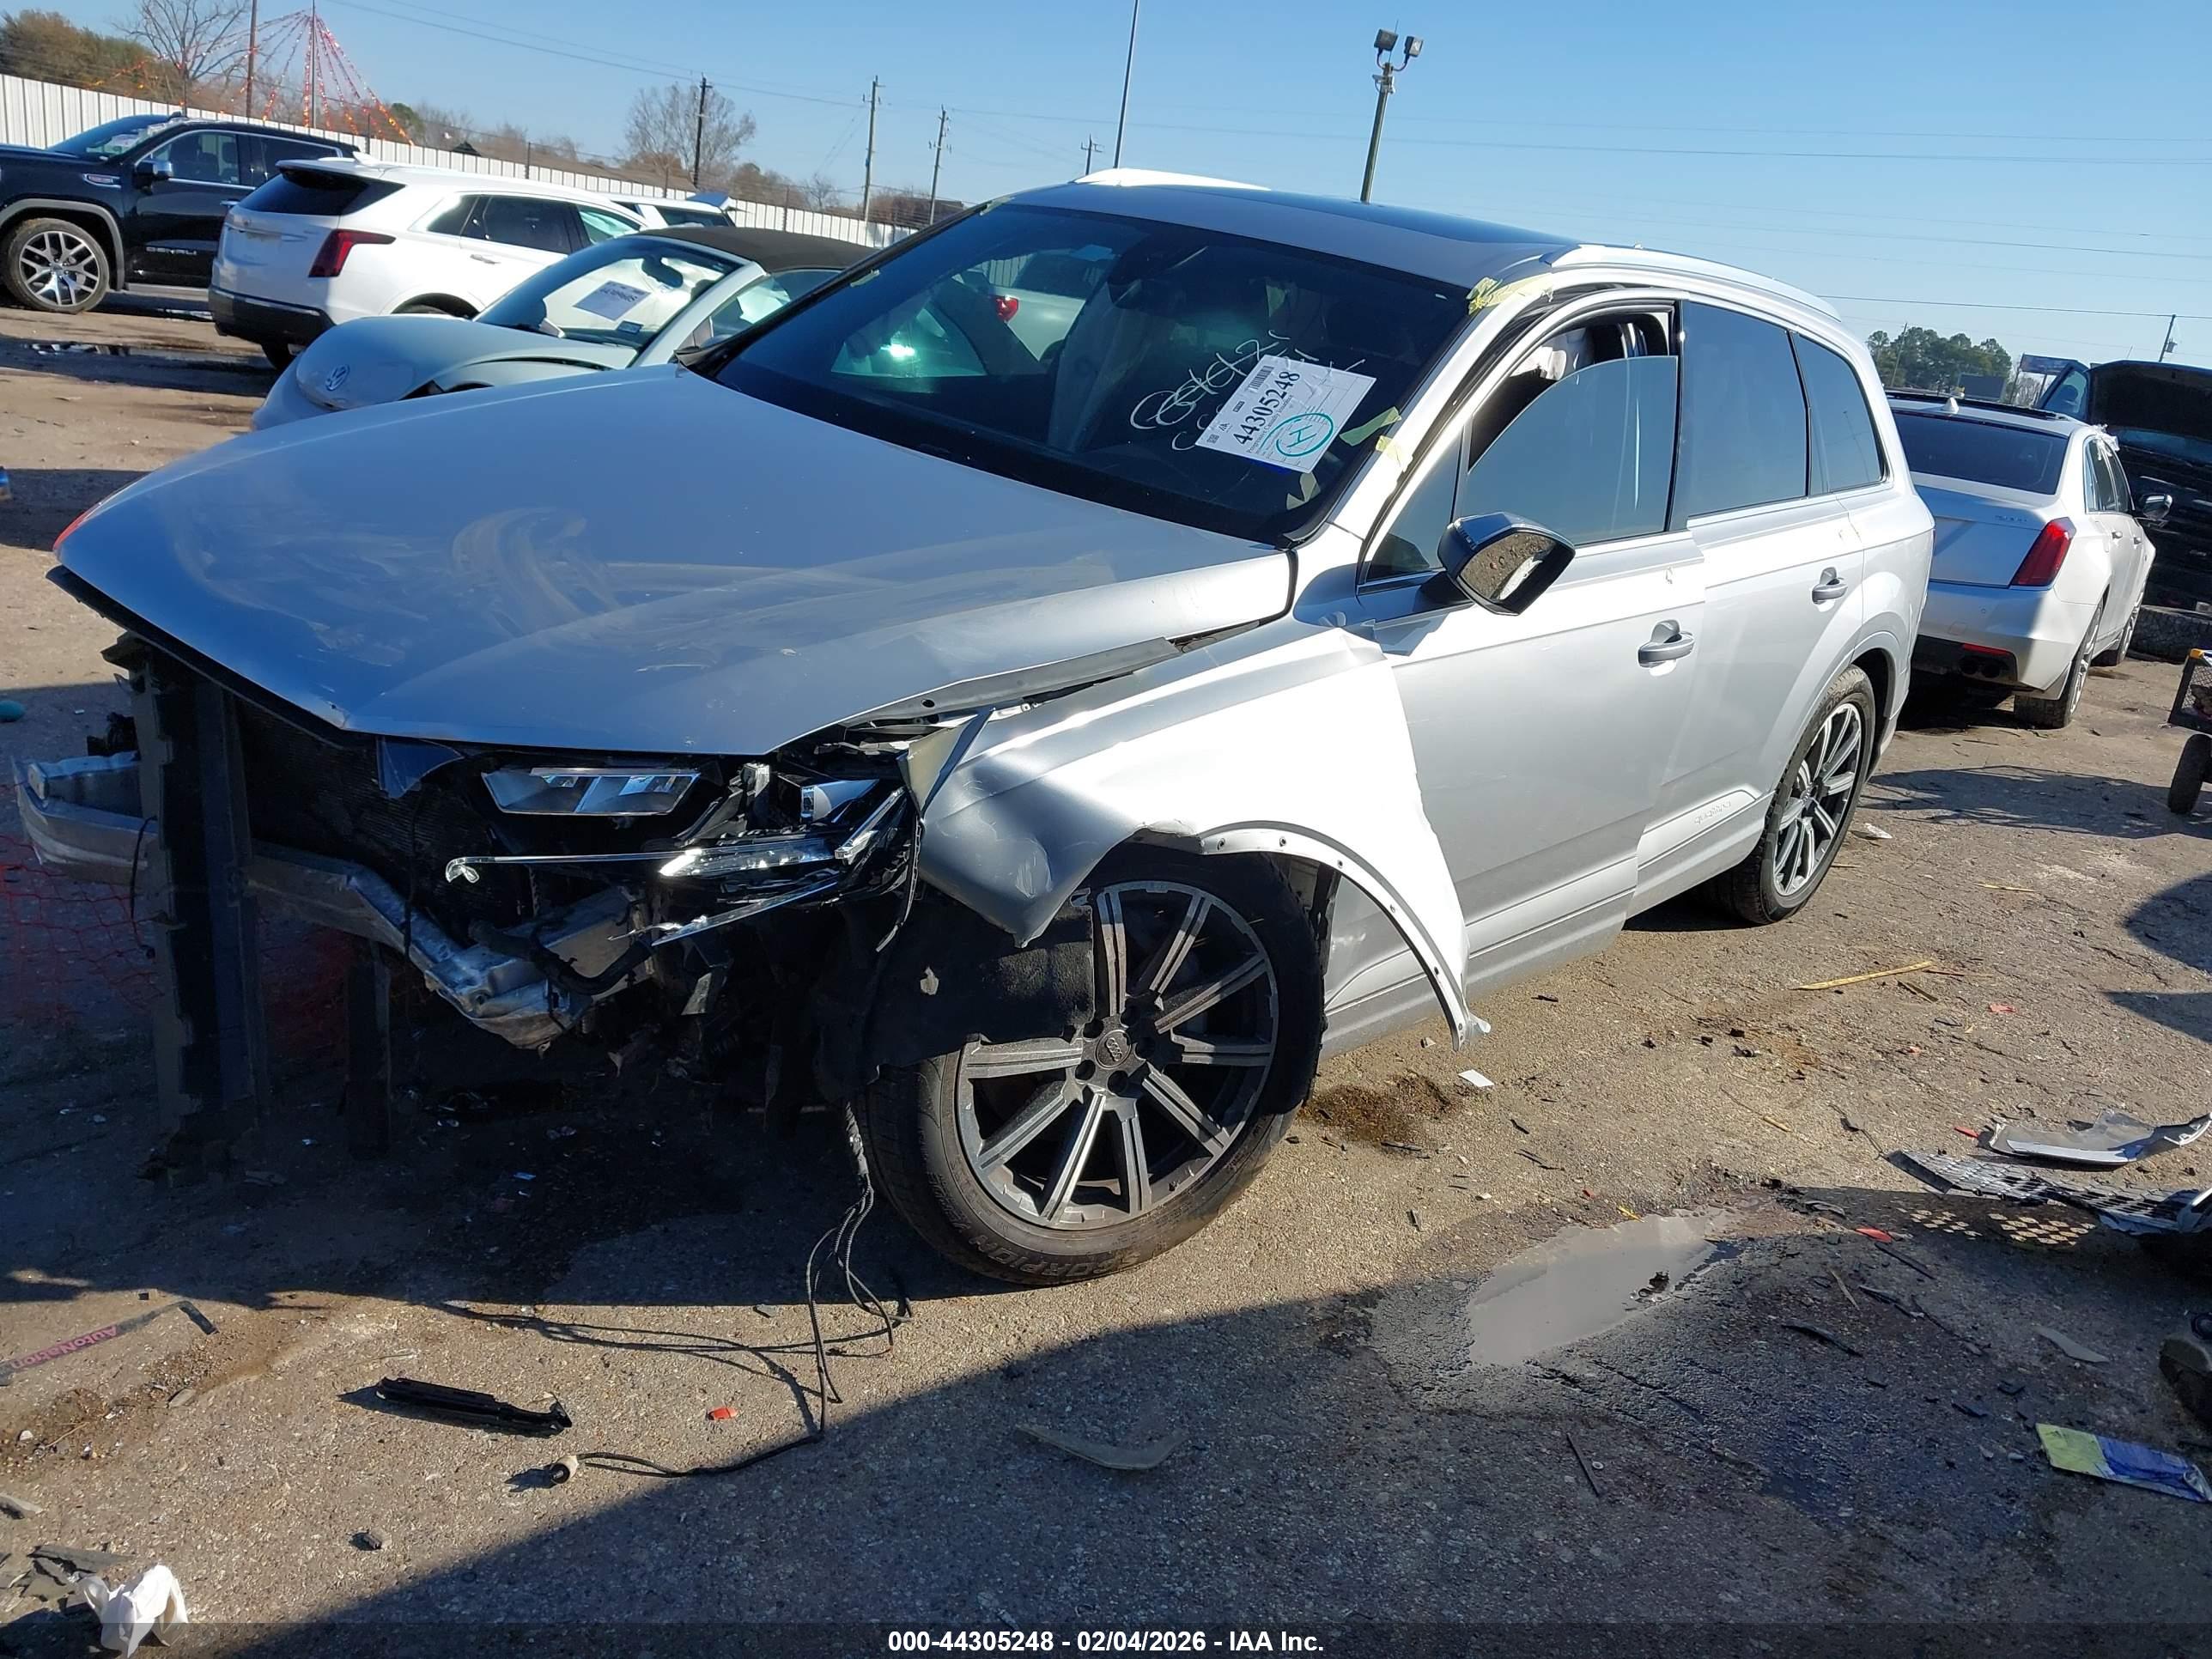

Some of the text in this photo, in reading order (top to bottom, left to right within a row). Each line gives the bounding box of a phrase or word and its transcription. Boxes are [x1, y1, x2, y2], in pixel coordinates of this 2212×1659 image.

[146, 246, 198, 255] DENALI
[1233, 371, 1300, 445] 44305248
[968, 1234, 1141, 1278] SCORPION
[10, 1325, 117, 1369] AutoNation
